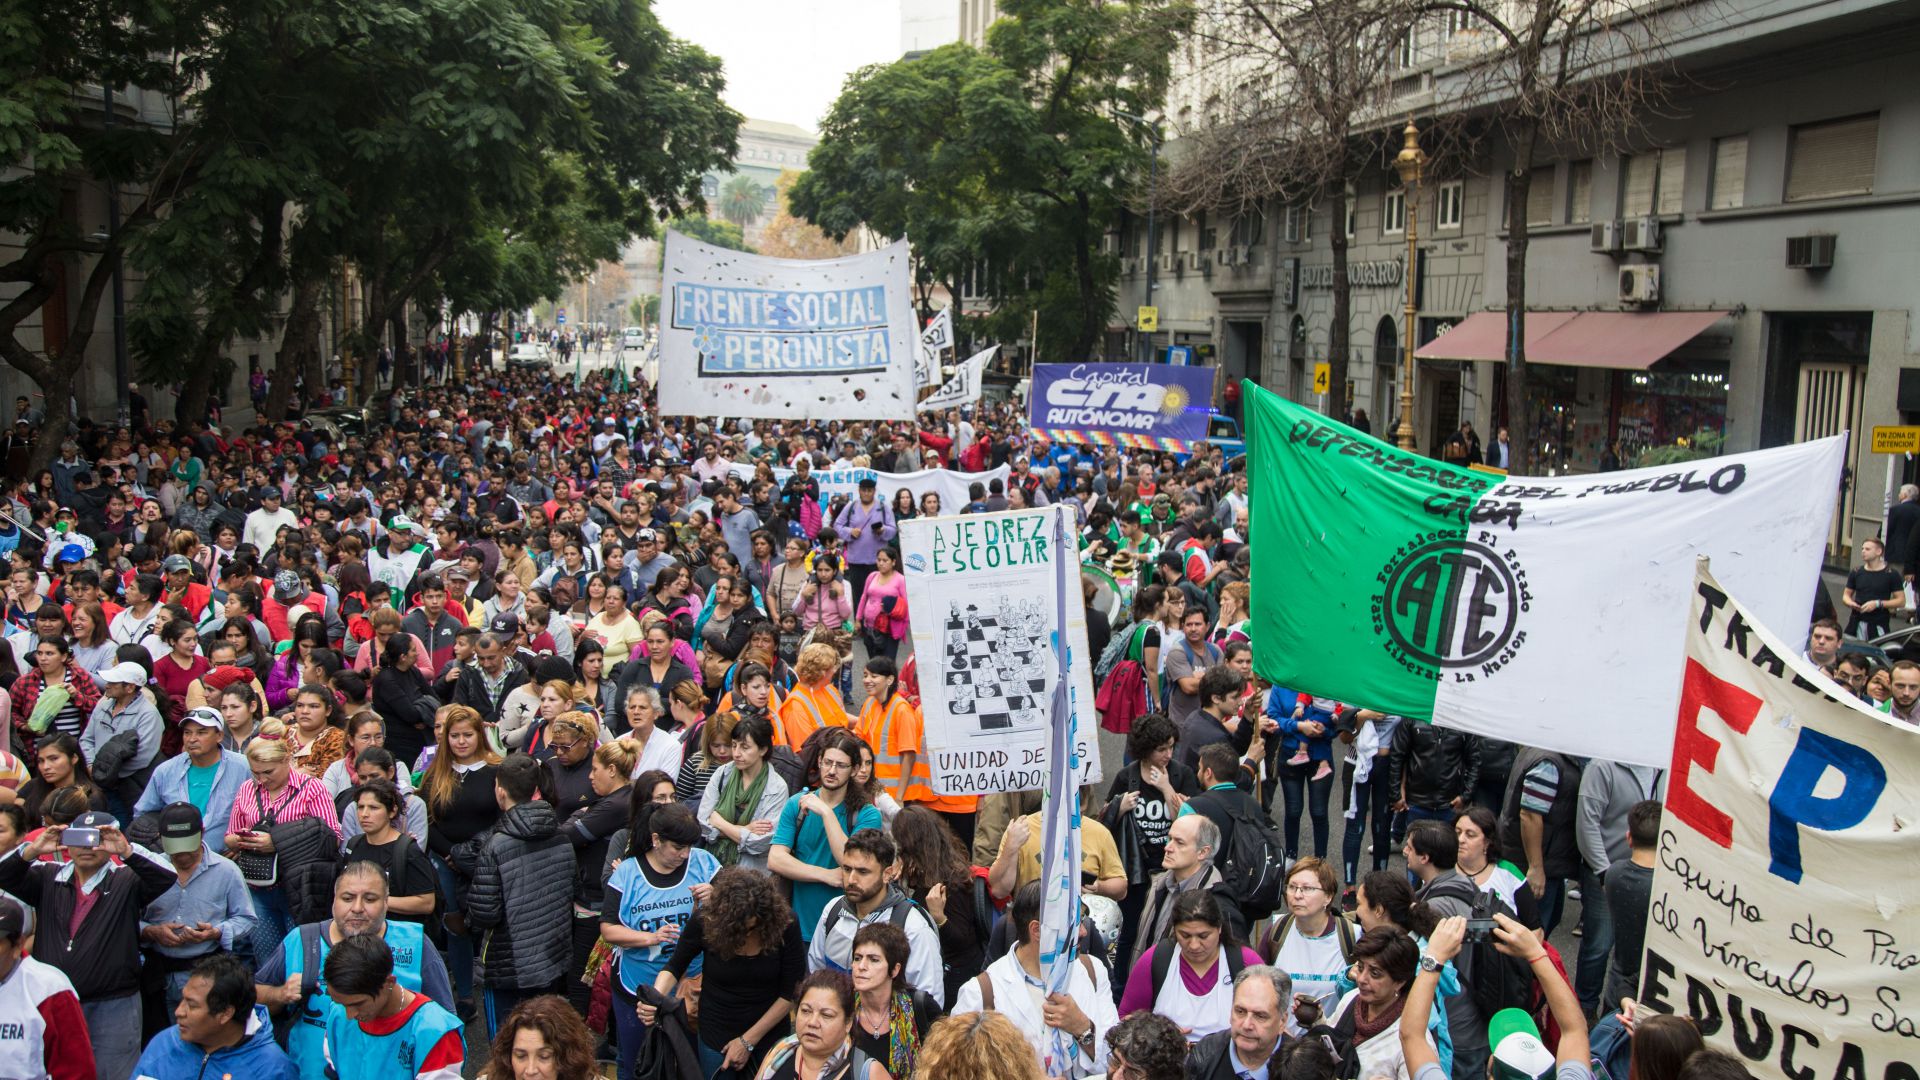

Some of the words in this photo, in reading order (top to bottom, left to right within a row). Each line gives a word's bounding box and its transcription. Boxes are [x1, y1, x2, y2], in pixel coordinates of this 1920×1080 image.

[678, 286, 779, 325] FRENTE
[786, 289, 882, 326] SOCIAL
[725, 332, 888, 370] PERONISTA
[1070, 364, 1150, 390] Capital
[1316, 371, 1327, 386] 4
[1046, 378, 1168, 413] CTA
[1047, 407, 1155, 430] AUTÓNOMA
[1288, 418, 1488, 494] DEFENSORIA
[1495, 484, 1569, 500] DEL
[1576, 463, 1747, 499] PUEBLO
[1423, 492, 1524, 531] CABA
[934, 516, 1047, 550] AJEDREZ
[933, 540, 1049, 574] ESCOLAR
[1376, 528, 1468, 585] Fortalecer
[1478, 531, 1498, 548] El
[1504, 549, 1533, 613] Estado
[1396, 551, 1505, 658] ATE
[1383, 639, 1444, 682] Liberar
[1455, 672, 1476, 683] La
[939, 750, 1009, 771] UNIDAD
[1022, 747, 1045, 765] DE
[631, 896, 695, 915] ORGANIZACI
[1660, 829, 1767, 927] Equipo
[1789, 913, 1847, 958] de
[1652, 893, 1684, 942] de
[0, 1024, 24, 1039] ERA
